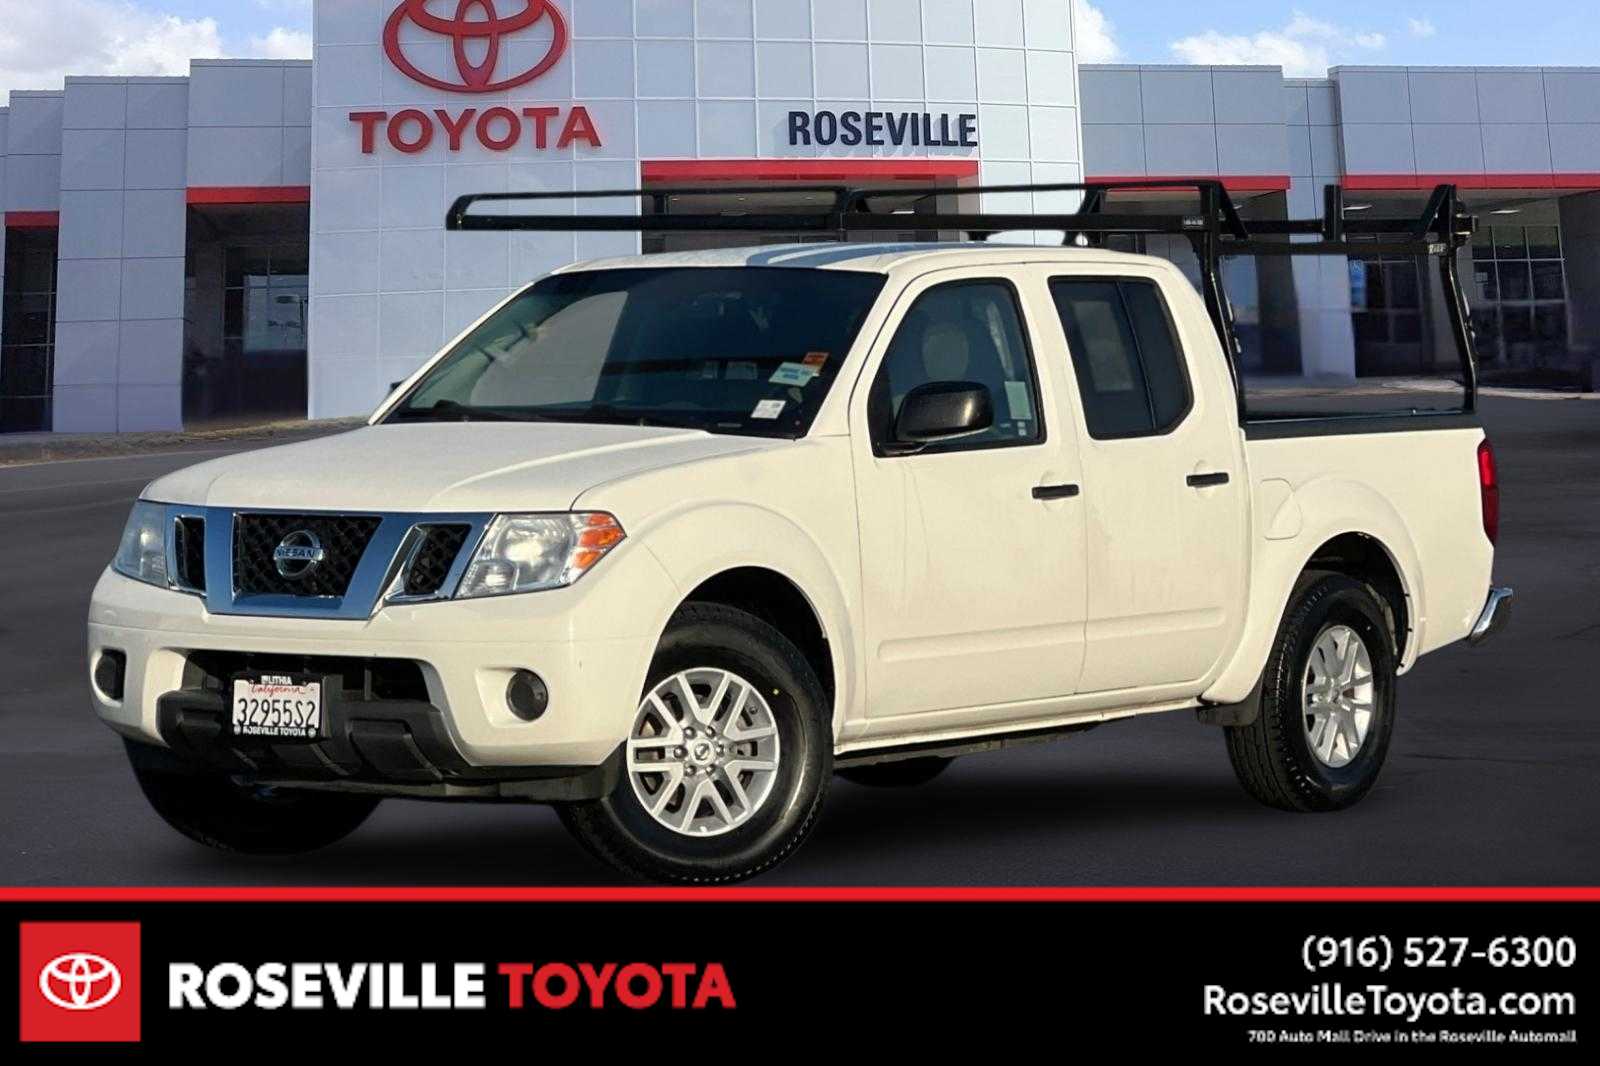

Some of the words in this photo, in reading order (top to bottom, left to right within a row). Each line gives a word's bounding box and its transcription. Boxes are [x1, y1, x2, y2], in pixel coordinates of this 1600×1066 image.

[349, 106, 602, 154] TOYOTA
[788, 110, 978, 147] ROSEVILLE
[251, 684, 306, 697] California
[237, 697, 316, 728] 32955S2
[242, 725, 279, 736] ROSEVILLE
[279, 726, 306, 737] TOYOTA
